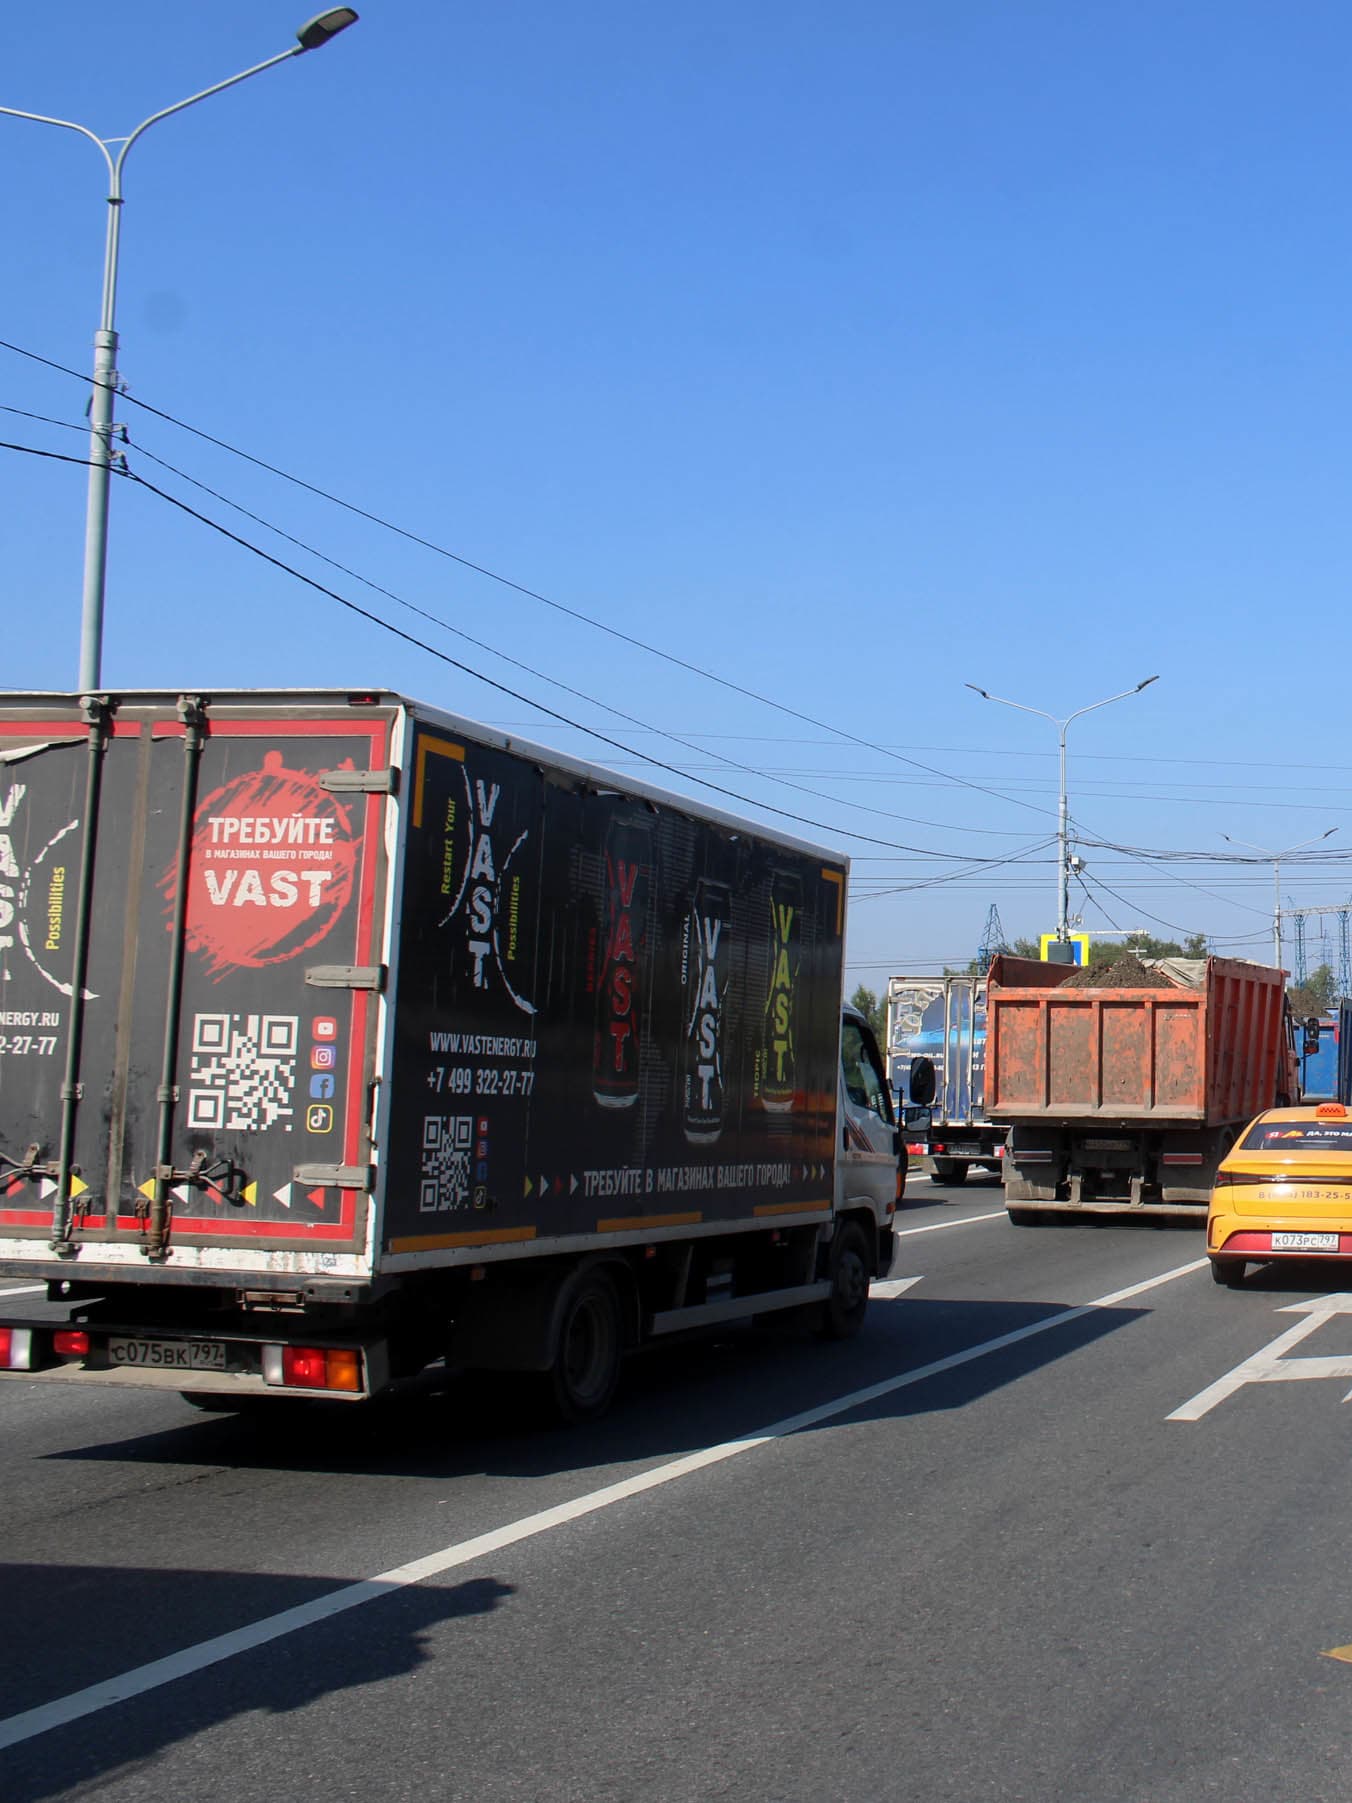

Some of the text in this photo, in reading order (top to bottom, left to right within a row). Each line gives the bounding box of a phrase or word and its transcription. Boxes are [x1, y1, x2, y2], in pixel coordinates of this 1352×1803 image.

[205, 849, 333, 861] В МАГАЗИНАХ ВАШЕГО ГОРОДА!
[208, 813, 335, 844] ТРЕБУЙТЕ
[441, 797, 456, 894] Restart Your
[45, 867, 65, 950] Possibilities
[204, 869, 333, 907] VAST
[468, 779, 500, 990] VAST
[506, 875, 520, 961] Possibilities
[609, 859, 638, 1072] VAST
[680, 914, 691, 985] ORIGINAL
[697, 916, 721, 1110] VAST
[773, 903, 794, 1082] VAST
[430, 1031, 537, 1058] WWW.VASTENERGY.RU
[427, 1066, 536, 1096] +7 499 322-27-77
[584, 1163, 791, 1197] ТРЕБУЙТЕ В МАГАЗИНАХ ВАШЕГО ГОРОДА!
[1320, 1235, 1336, 1243] 797
[191, 1343, 220, 1360] 797
